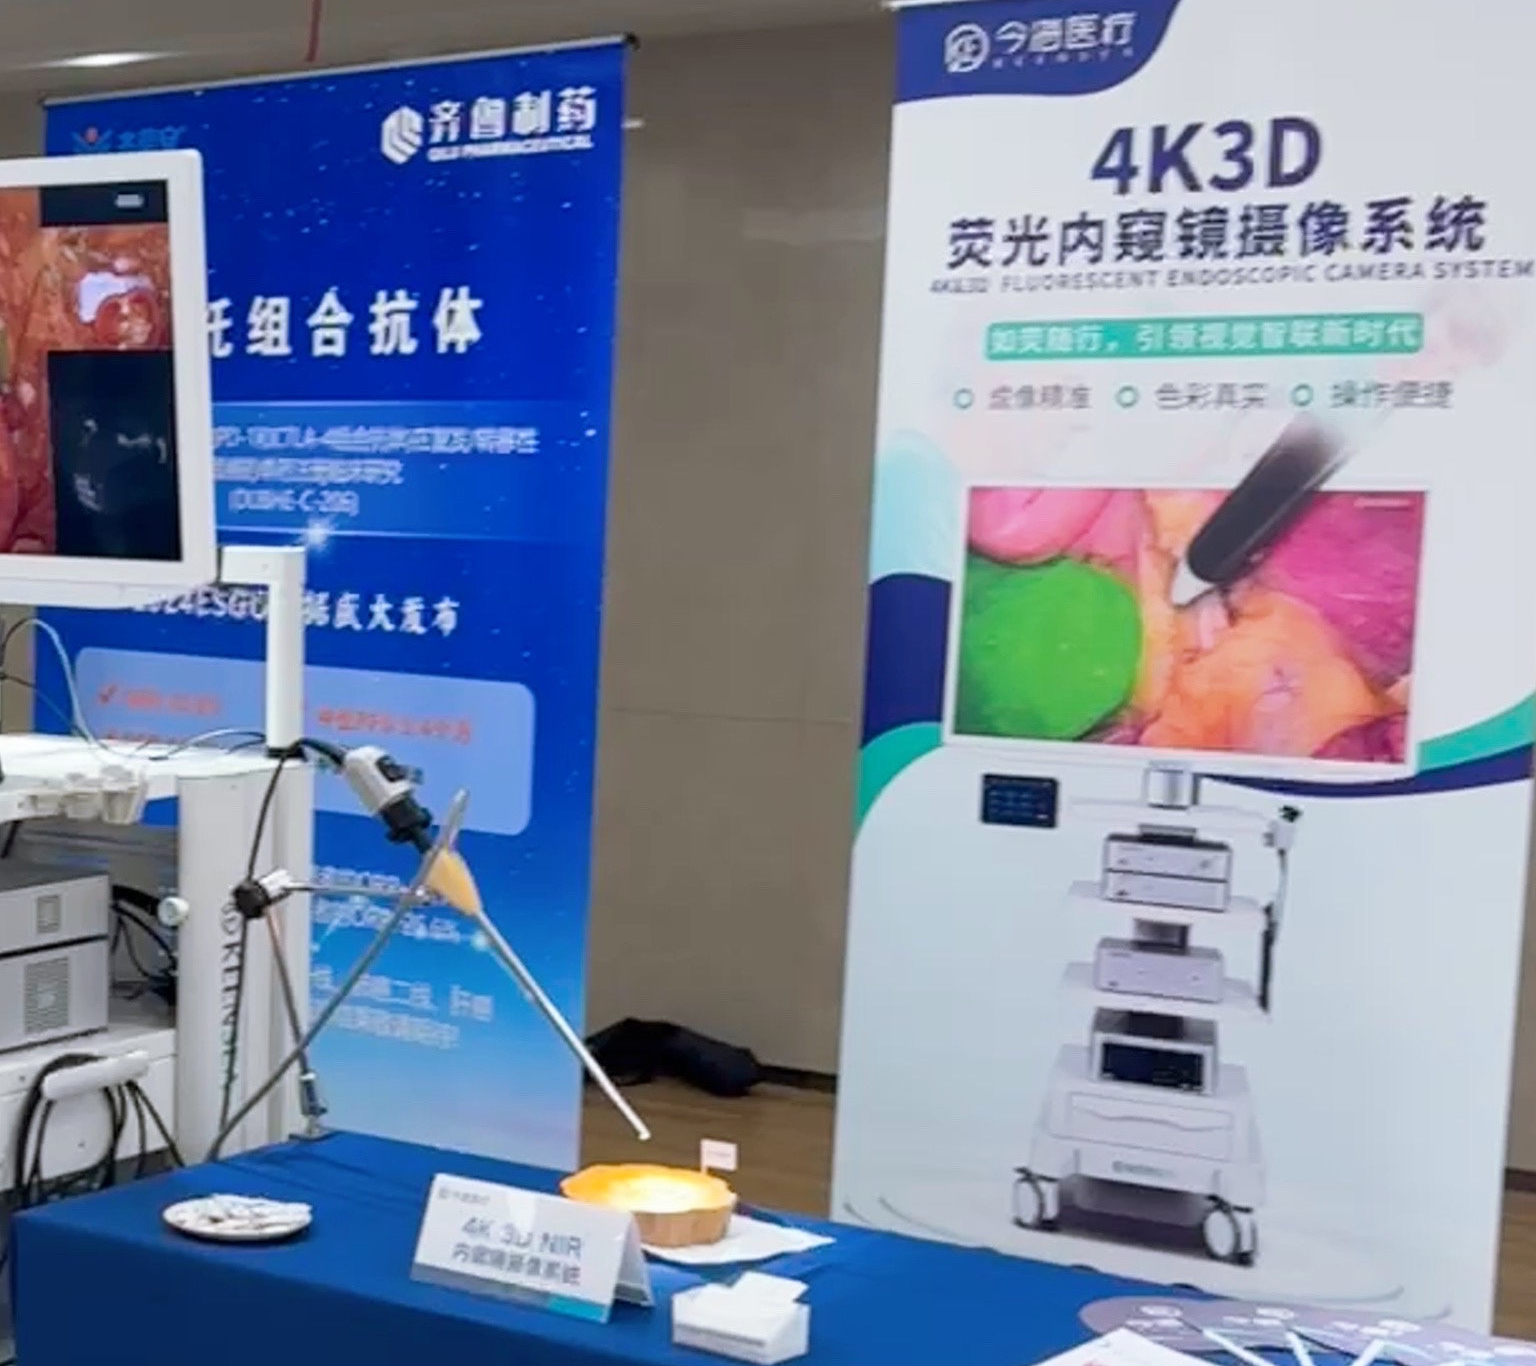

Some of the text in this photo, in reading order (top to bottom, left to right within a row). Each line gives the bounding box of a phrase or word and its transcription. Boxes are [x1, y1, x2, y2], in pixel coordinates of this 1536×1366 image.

[428, 85, 596, 144] 齐鲁制药
[1091, 115, 1323, 195] 4K3D
[947, 194, 1487, 271] 荧光内窥镜摄像系统
[1000, 269, 1161, 293] FLUORESCENT
[1166, 264, 1317, 288] ENDOSCOPIC
[1323, 262, 1425, 283] CAMERA
[1432, 259, 1535, 280] SYSTEM
